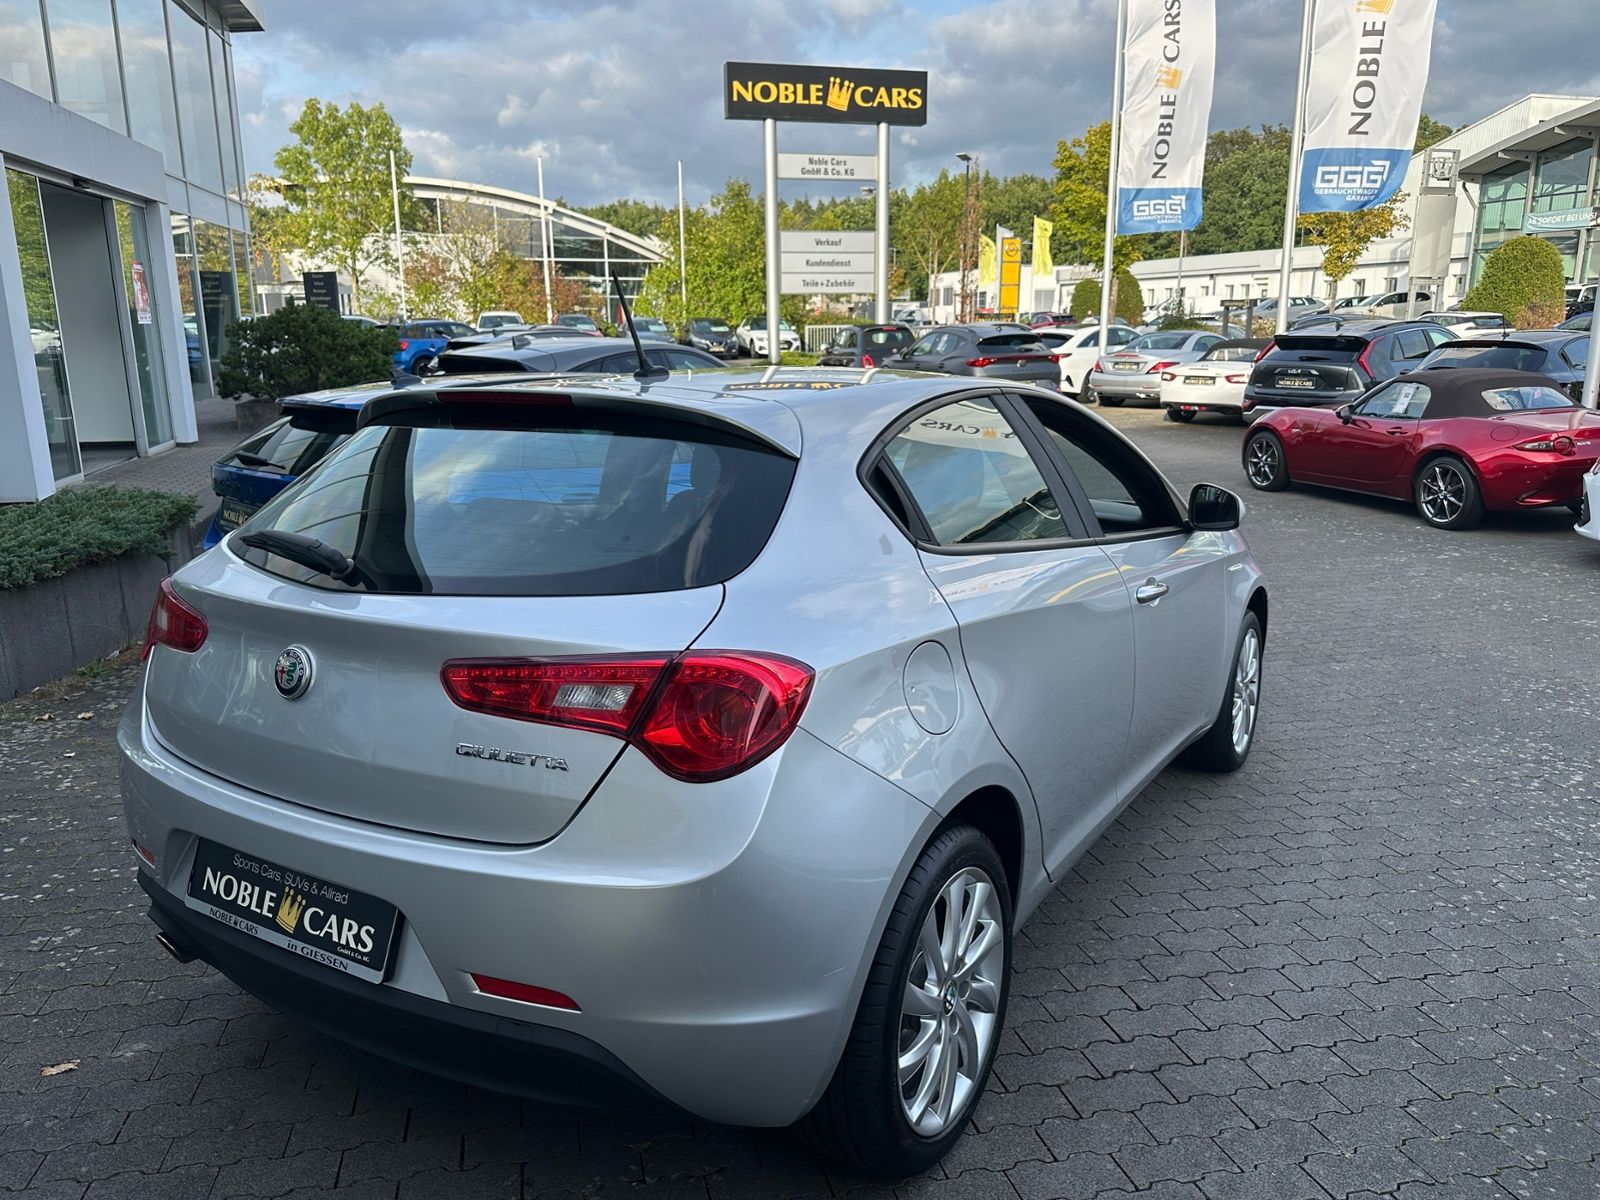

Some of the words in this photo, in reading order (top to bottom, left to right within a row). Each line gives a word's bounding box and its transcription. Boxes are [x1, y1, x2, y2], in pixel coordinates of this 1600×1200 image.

[1163, 0, 1181, 63] CARS
[1347, 20, 1386, 136] NOBLE
[731, 80, 823, 105] NOBLE
[853, 85, 922, 110] CARS
[1151, 94, 1177, 179] NOBLE
[800, 167, 821, 176] GmbH
[823, 168, 829, 176] &
[830, 168, 843, 176] Co.
[844, 168, 855, 177] KG
[808, 157, 828, 166] Noble
[830, 157, 847, 166] Cars
[1315, 165, 1384, 188] GGG
[1133, 198, 1183, 216] GGG
[1537, 214, 1567, 225] SOFORT
[1566, 213, 1578, 222] BEI
[814, 238, 843, 246] Verkauf
[805, 259, 851, 267] Kundendienst
[456, 742, 569, 771] GIULIETTA
[233, 853, 260, 874] Sports
[284, 872, 310, 892] SUVs
[310, 882, 318, 894] &
[319, 885, 349, 905] Allrad
[202, 866, 277, 918] NOBLE
[303, 906, 376, 953] CARS
[209, 906, 234, 925] NOBLE
[238, 920, 259, 936] CARS
[287, 940, 298, 952] in
[300, 946, 349, 971] GIESSEN
